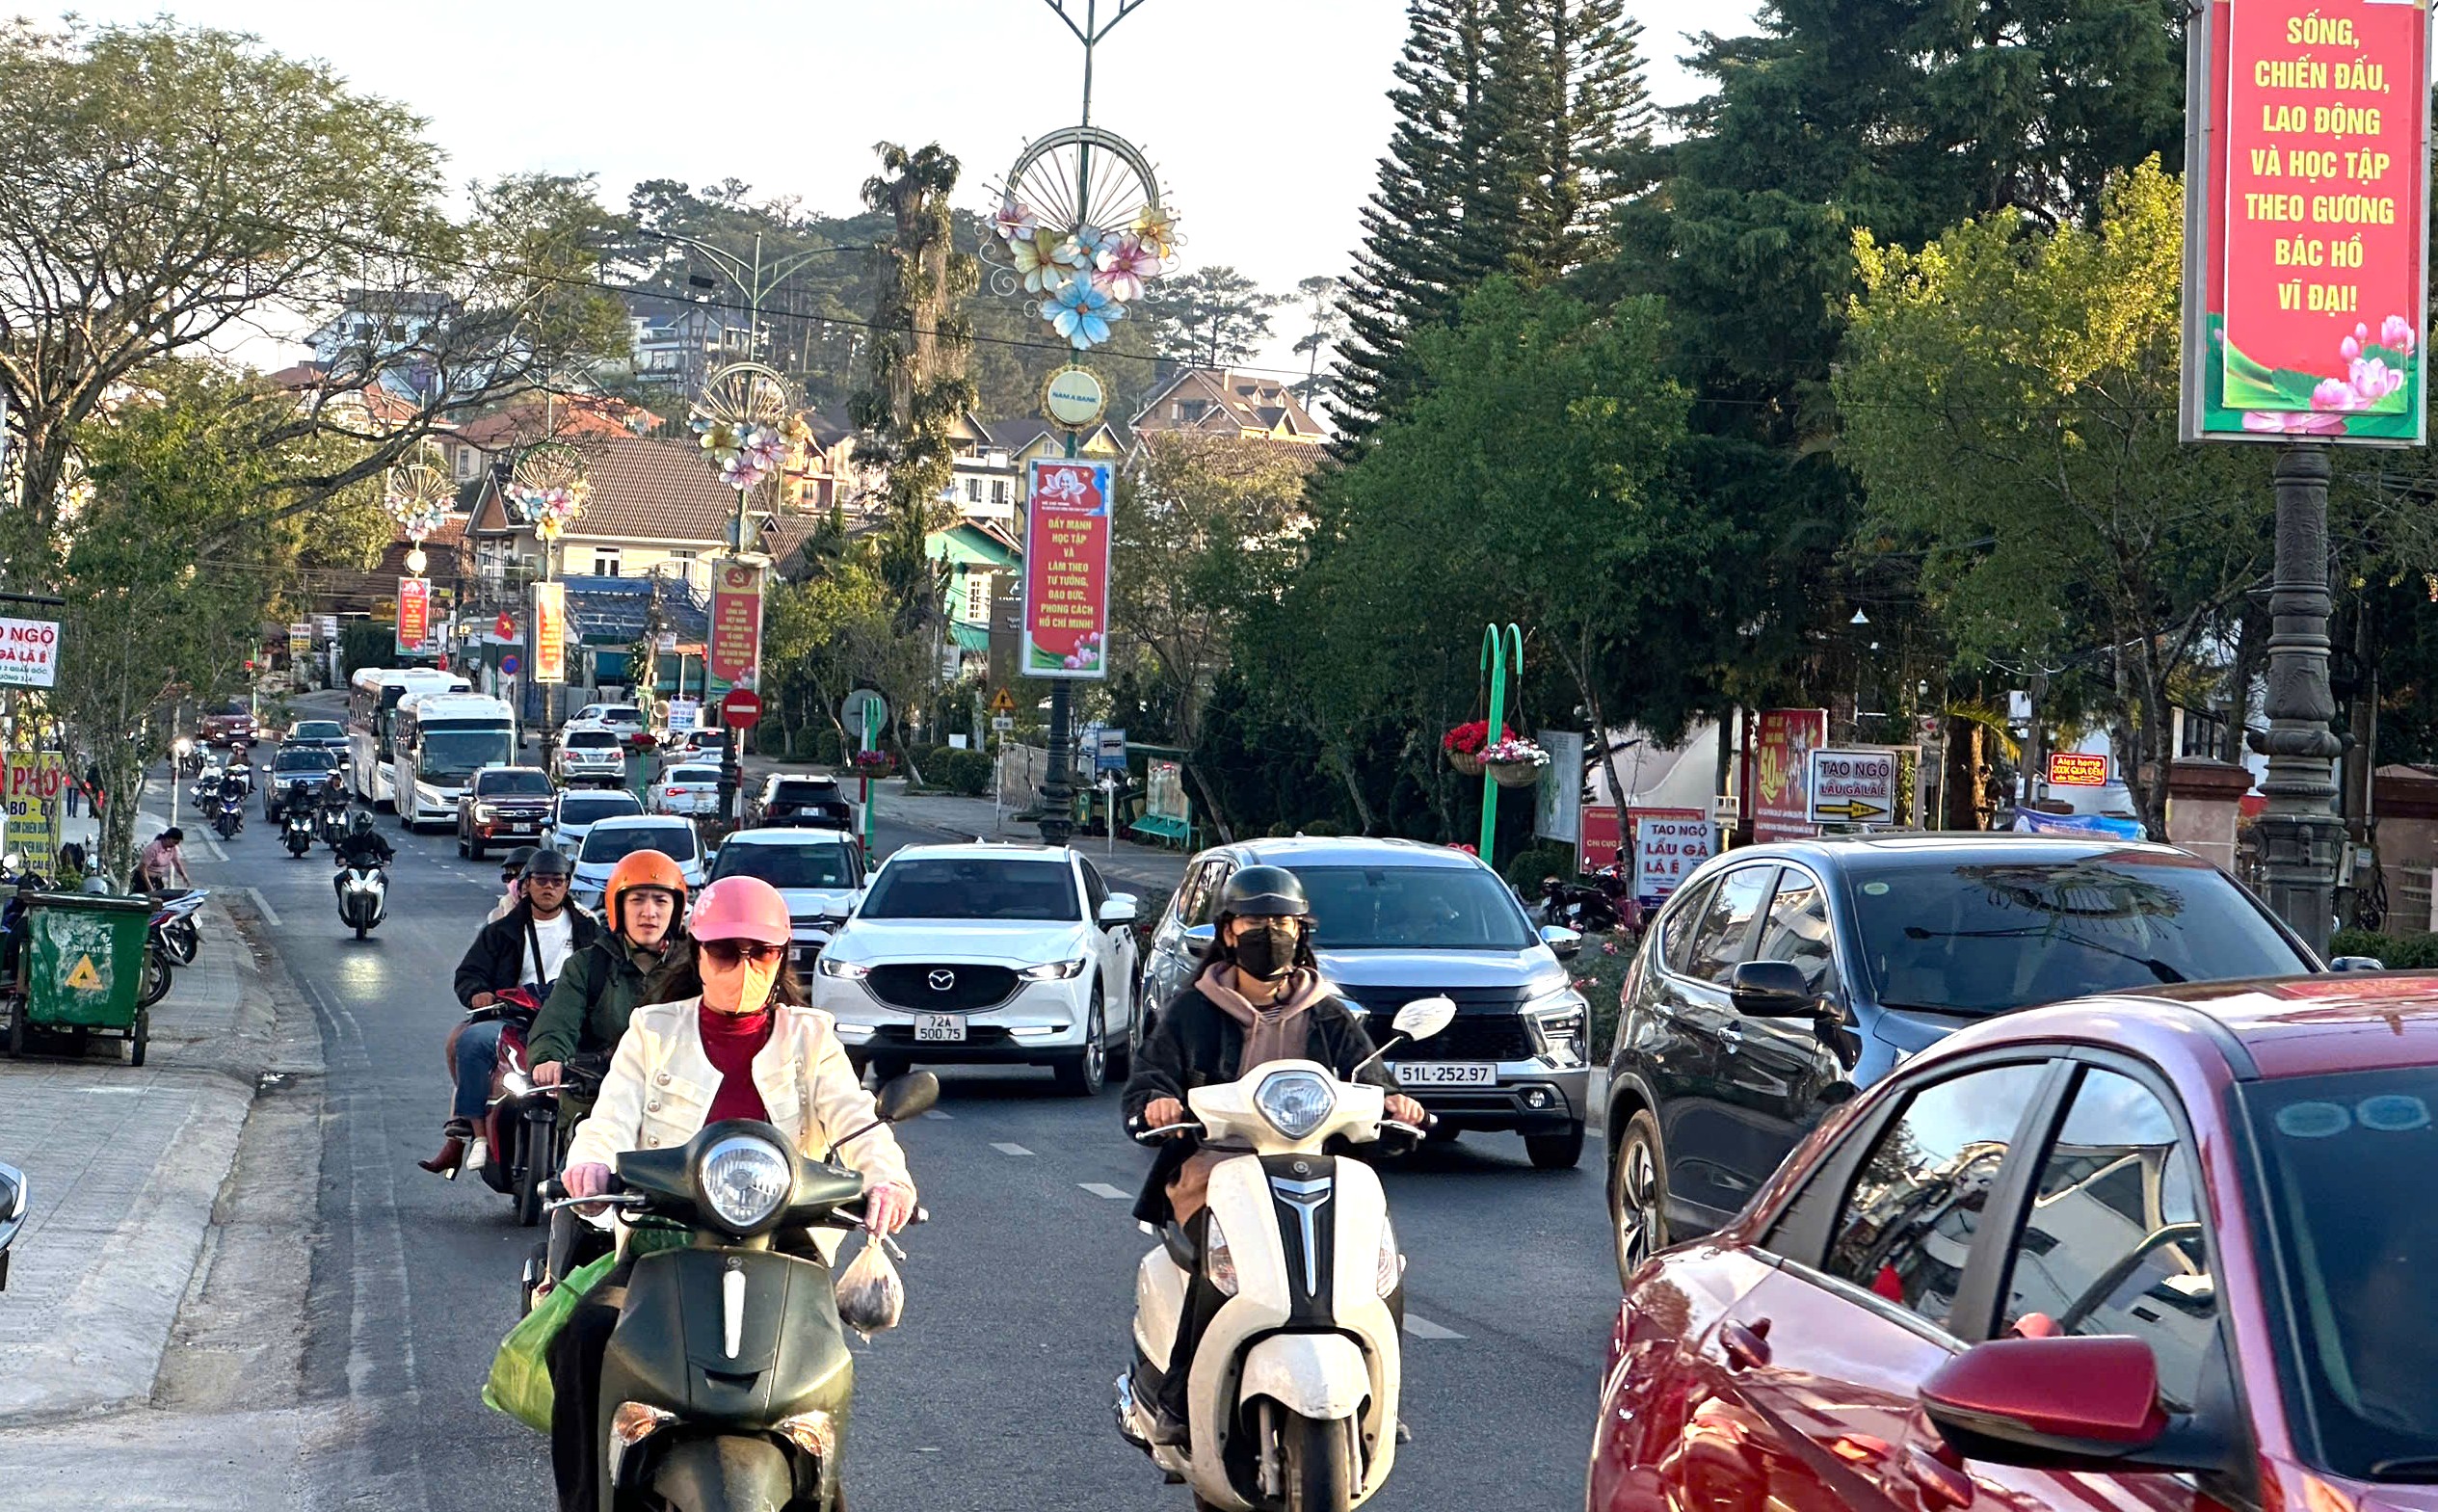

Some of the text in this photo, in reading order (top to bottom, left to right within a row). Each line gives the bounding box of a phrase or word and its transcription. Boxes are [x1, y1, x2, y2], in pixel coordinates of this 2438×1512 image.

[2287, 9, 2360, 48] SỐNG,
[2255, 54, 2390, 93] CHIẾN ĐẤU,
[2263, 102, 2380, 140] LAO ĐỘNG
[2251, 145, 2390, 185] VÀ HỌC TẬP
[2245, 194, 2395, 225] THEO GƯƠNG
[2275, 233, 2364, 269] BÁC HỒ
[2278, 279, 2357, 317] VĨ ĐẠI!
[1052, 533, 1070, 545] HỌC
[1063, 546, 1074, 558] VÀ
[1068, 562, 1089, 572] THEO
[1041, 603, 1094, 615] PHONG CÁCH
[1820, 760, 1850, 776] TAO
[2078, 757, 2101, 767] home
[1651, 824, 1676, 836] TAO
[930, 1017, 951, 1027] 72A
[920, 1028, 961, 1040] 500.75
